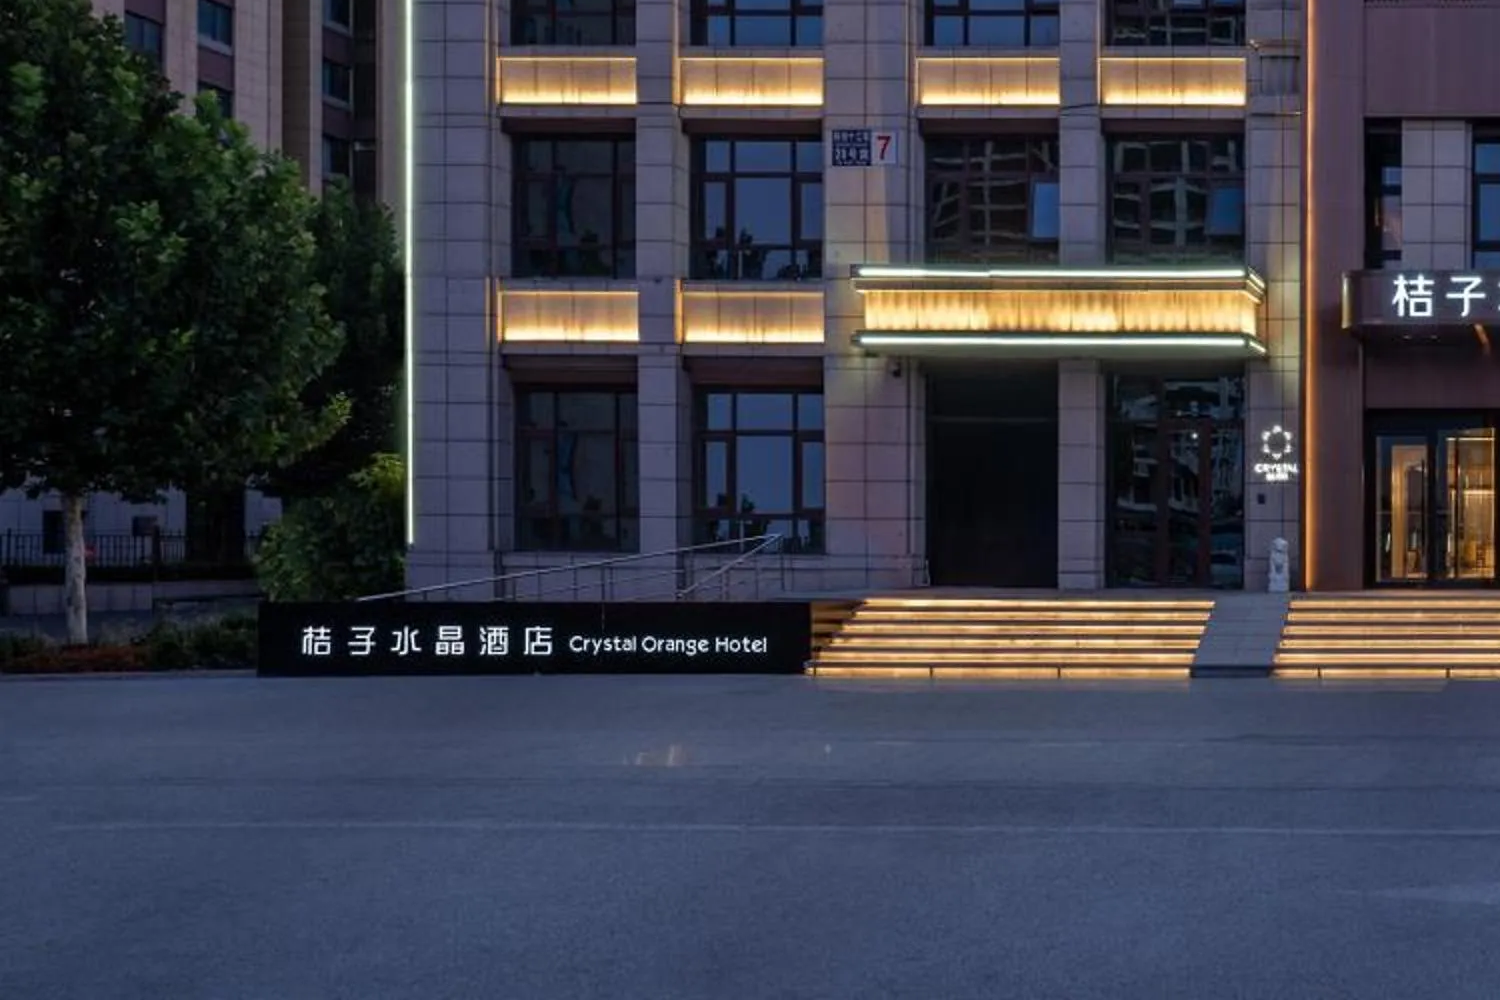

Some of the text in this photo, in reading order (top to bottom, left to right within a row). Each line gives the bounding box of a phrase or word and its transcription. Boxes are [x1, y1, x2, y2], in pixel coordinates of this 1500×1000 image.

[877, 135, 891, 160] 7
[302, 626, 553, 655] 桔子水晶酒店
[569, 635, 767, 656] Crystal Orange Hotel
